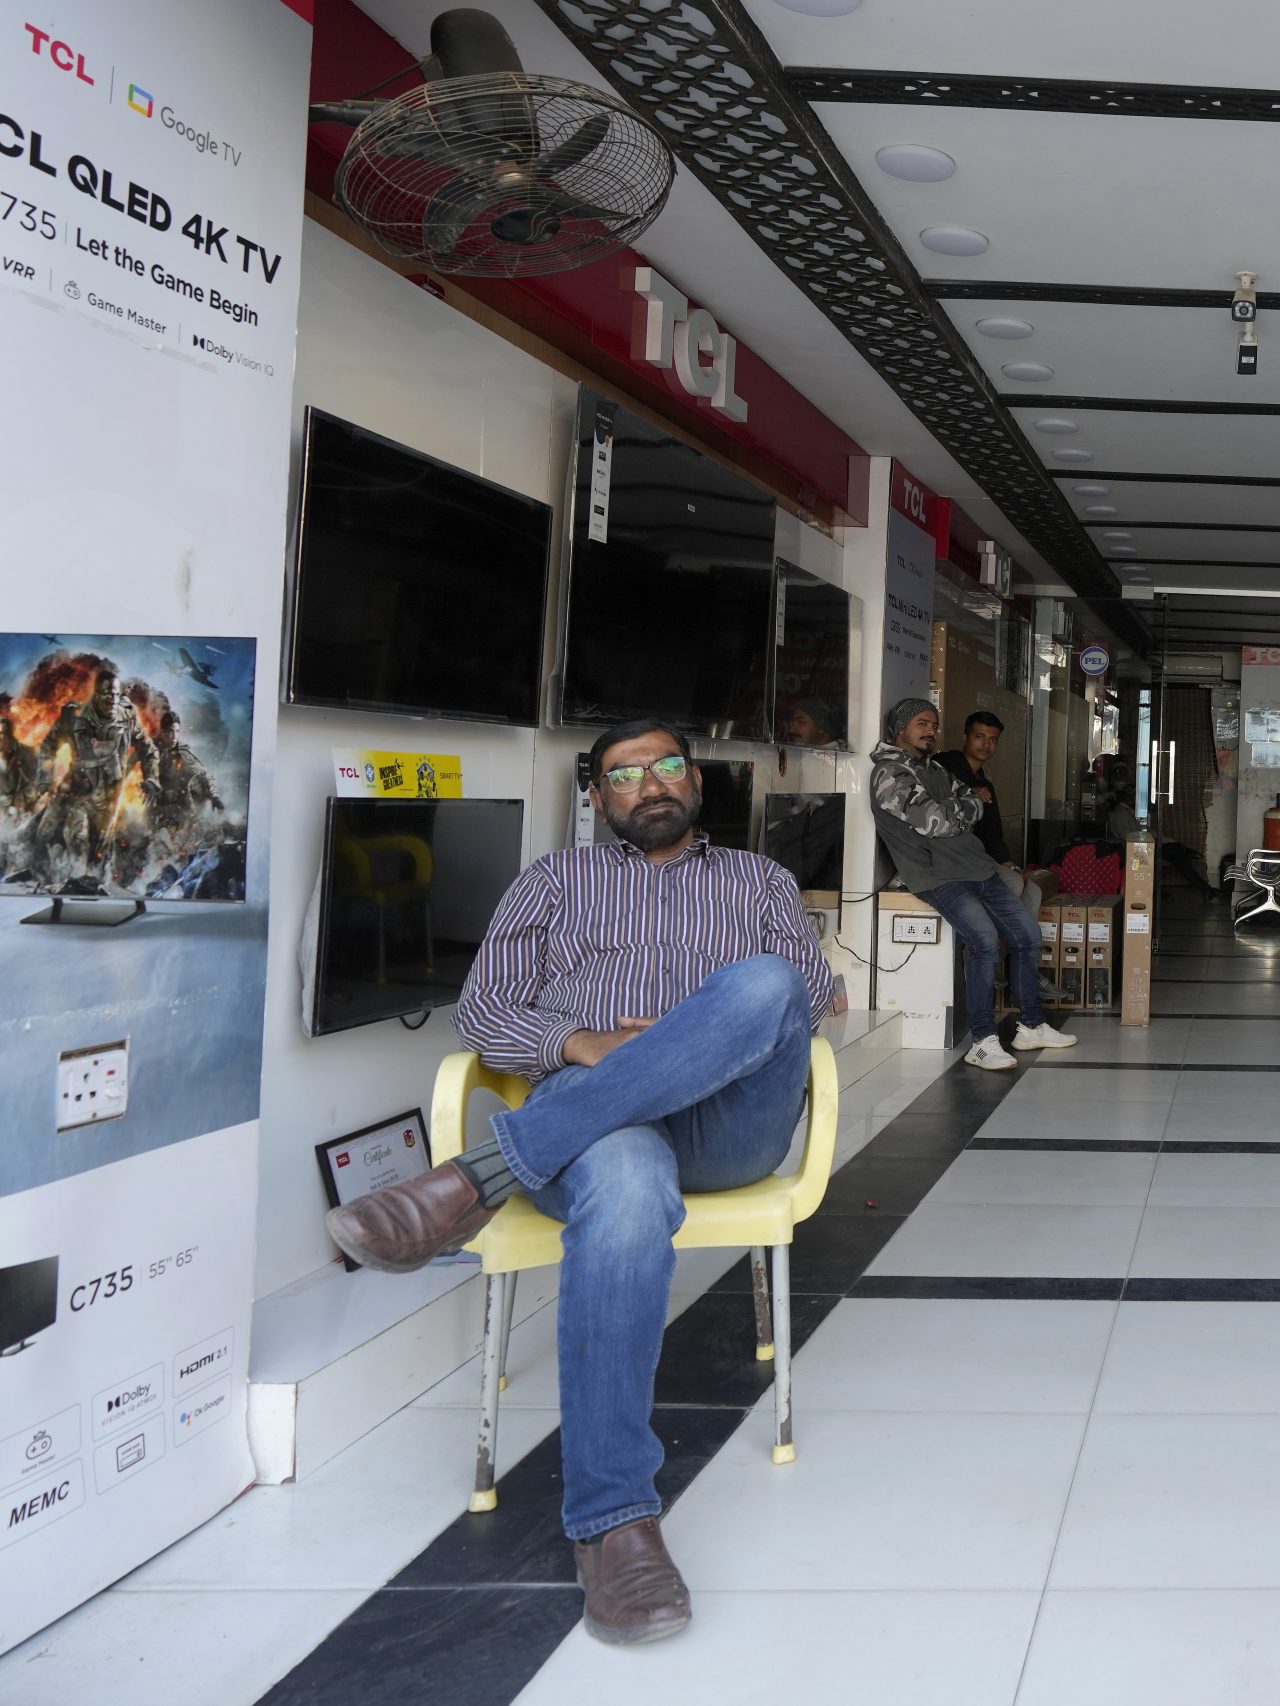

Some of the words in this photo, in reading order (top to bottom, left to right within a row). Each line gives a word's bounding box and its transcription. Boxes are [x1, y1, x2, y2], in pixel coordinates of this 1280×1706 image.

[25, 22, 94, 85] TCL
[160, 106, 218, 155] Google
[222, 142, 242, 167] TV
[68, 154, 172, 232] QLED
[181, 214, 230, 263] 4K
[236, 234, 282, 284] TV
[3, 257, 35, 280] VRR
[76, 228, 108, 261] Let
[114, 248, 145, 276] the
[150, 264, 204, 302] Game
[209, 289, 258, 326] Begin
[88, 292, 124, 318] Game
[127, 308, 166, 334] Master
[206, 340, 234, 362] Dolby
[236, 353, 261, 372] Vision
[635, 267, 748, 422] TCL
[904, 479, 926, 524] TCL
[339, 768, 359, 778] TCL
[70, 1266, 133, 1312] C735
[180, 1352, 214, 1379] HDMI
[217, 1346, 228, 1360] 2.1
[122, 1383, 151, 1406] Dolby
[8, 1480, 70, 1528] MEMC
